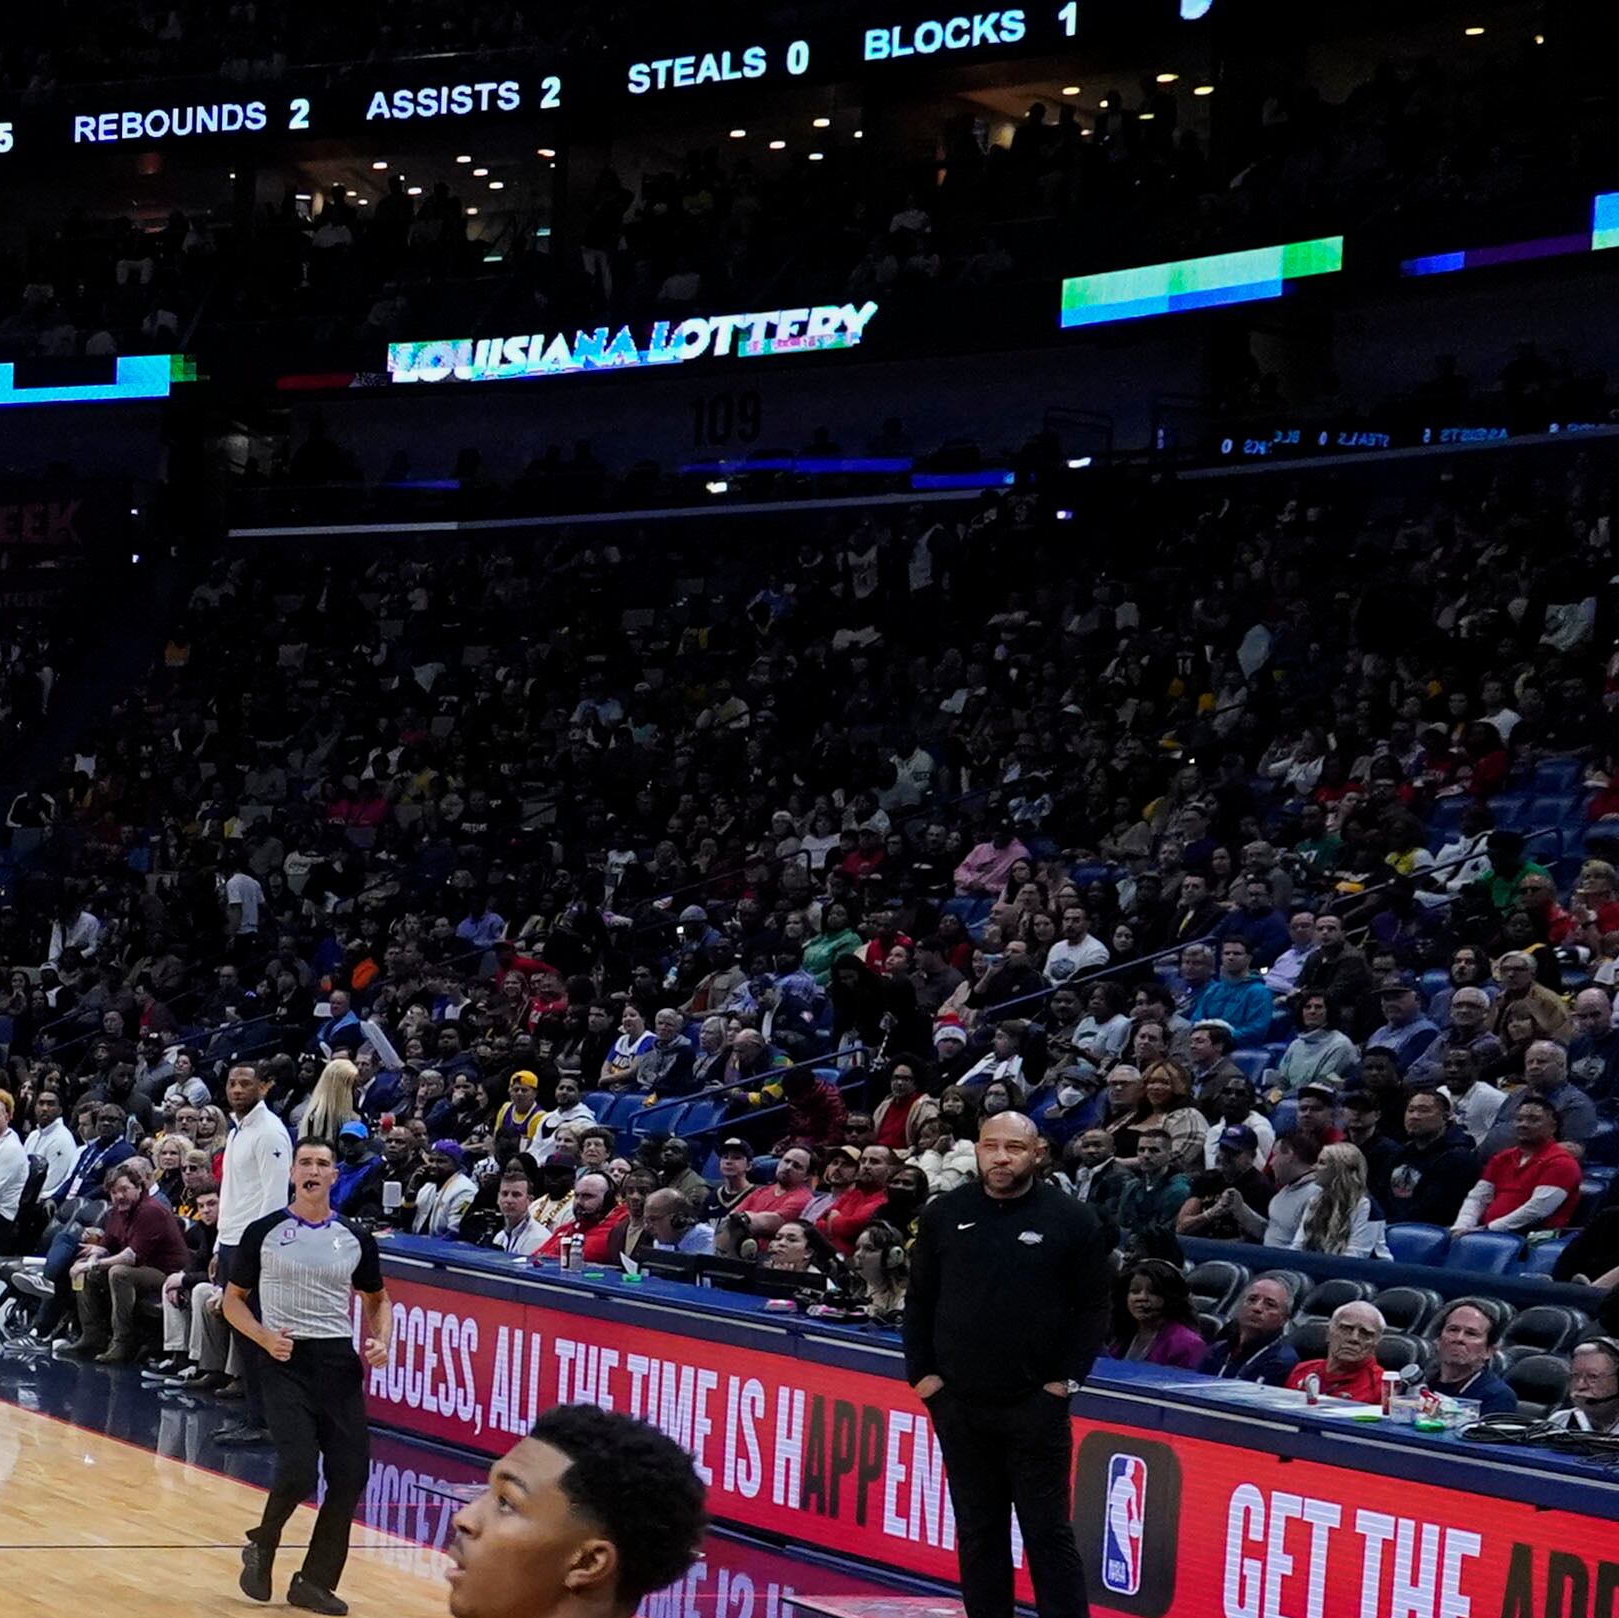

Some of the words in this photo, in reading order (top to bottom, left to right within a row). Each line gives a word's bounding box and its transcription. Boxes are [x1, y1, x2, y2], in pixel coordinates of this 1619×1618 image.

[75, 102, 268, 144] REBOUNDS
[289, 99, 311, 131] 2
[367, 81, 521, 122] ASSISTS
[541, 77, 562, 110] 2
[628, 47, 768, 95] STEALS
[787, 41, 811, 76] 0
[865, 10, 1027, 62] BLOCKS
[1058, 2, 1078, 37] 1
[389, 324, 642, 385] LOUISIANA
[647, 301, 879, 365] LOTTERY
[689, 390, 762, 446] 109
[489, 1325, 542, 1436] ALL
[553, 1337, 621, 1422] THE
[626, 1353, 719, 1484] TIME
[723, 1375, 764, 1500] IS
